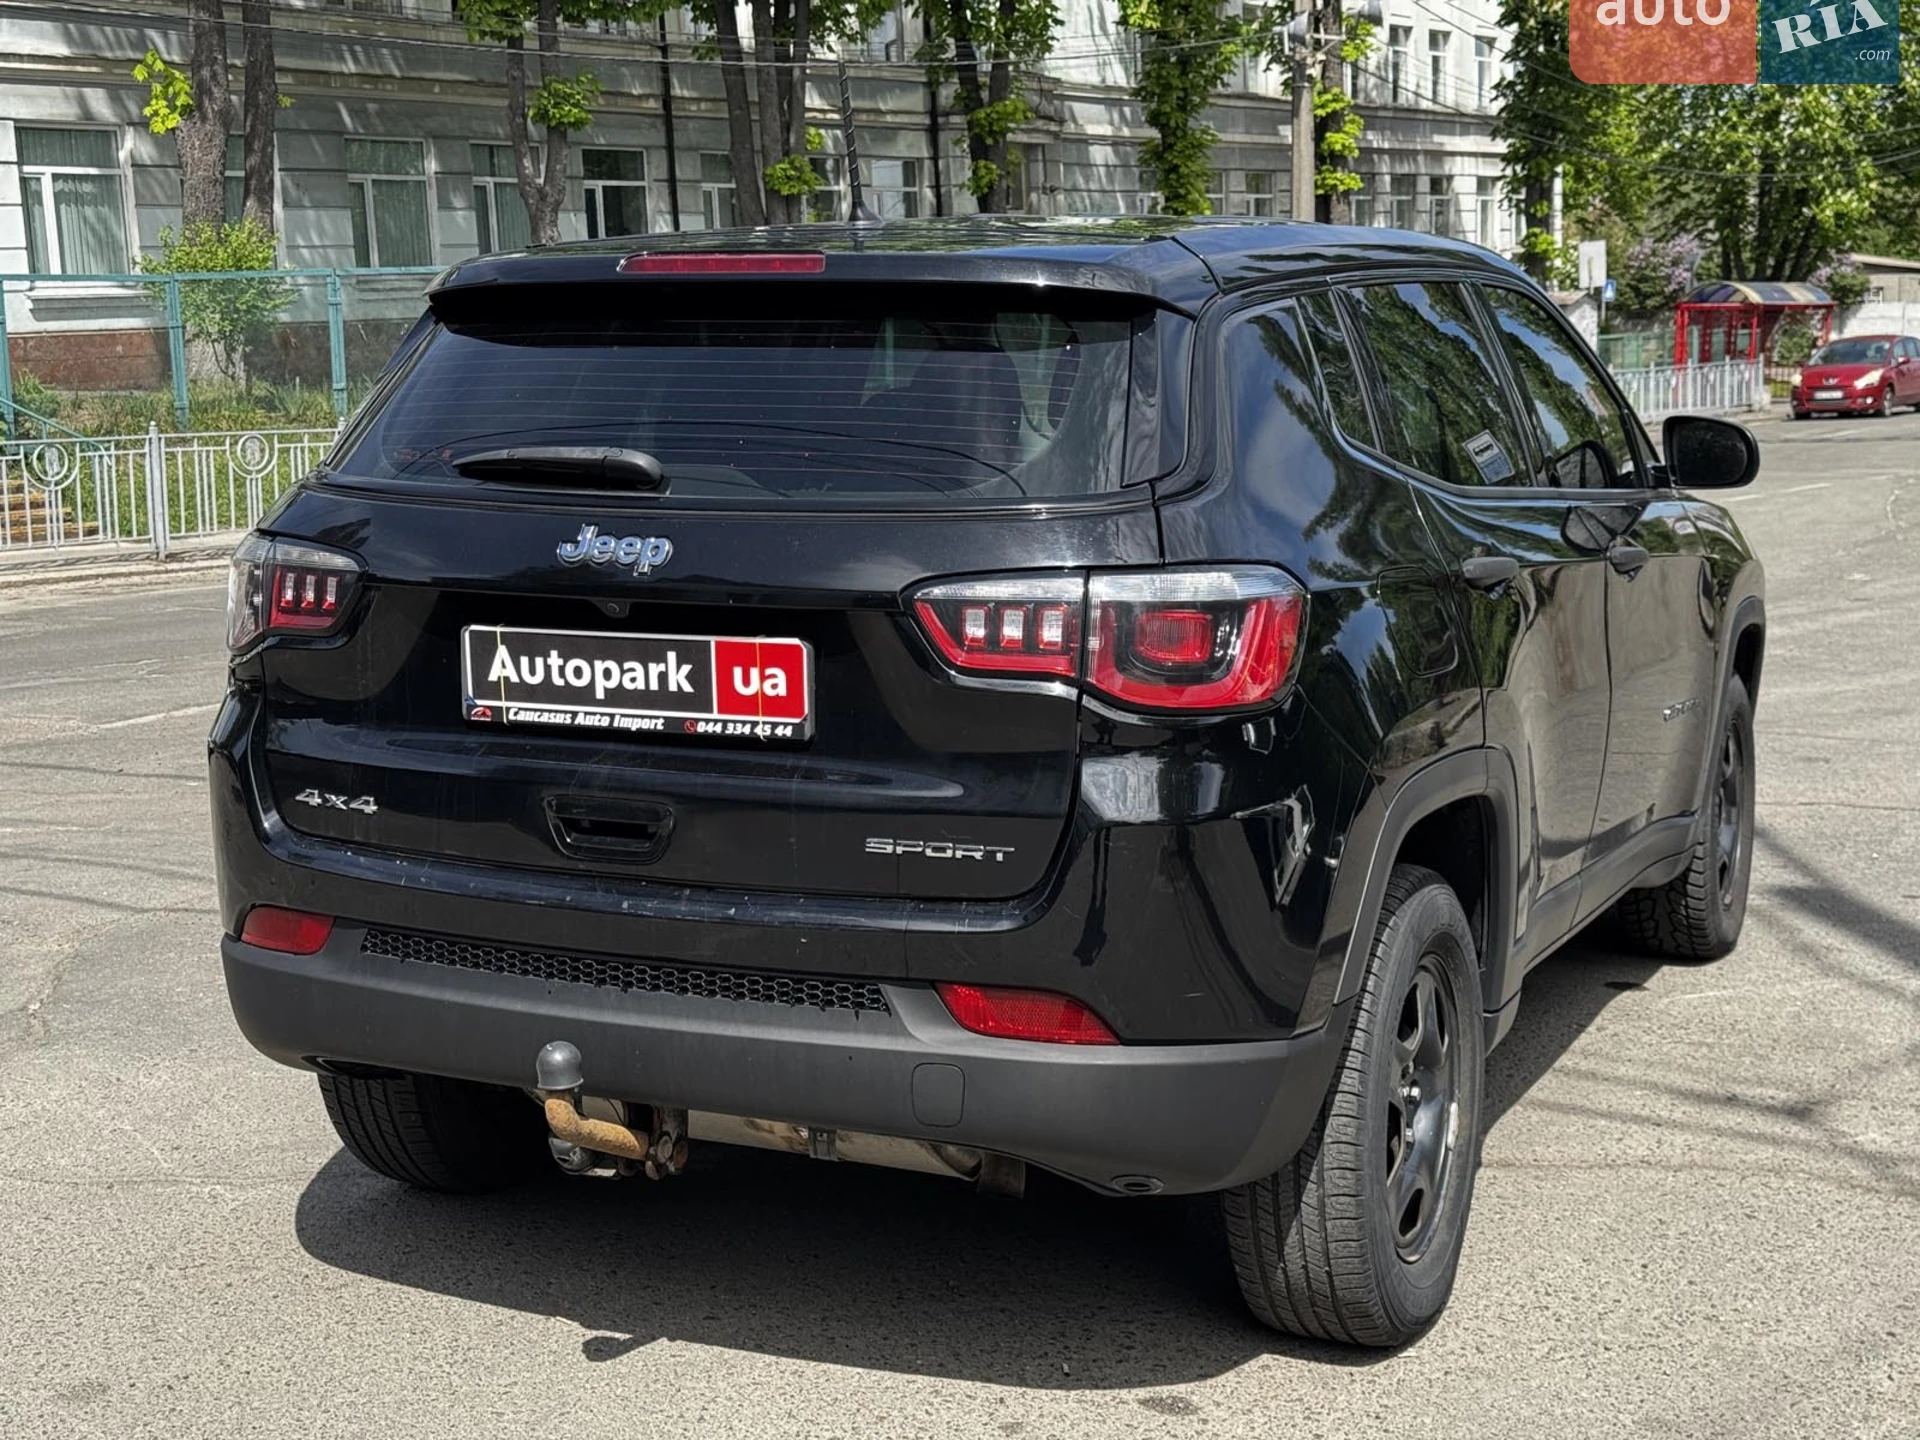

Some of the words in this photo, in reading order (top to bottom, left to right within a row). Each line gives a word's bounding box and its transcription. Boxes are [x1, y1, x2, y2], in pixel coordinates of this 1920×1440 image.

[557, 523, 673, 576] Jeep
[487, 644, 695, 700] Autopark
[732, 665, 788, 698] ua
[508, 707, 572, 725] Caucasus
[574, 712, 610, 727] Auto
[612, 714, 665, 731] Import
[696, 721, 723, 734] 044
[725, 723, 752, 735] 334
[753, 724, 772, 736] 45
[774, 725, 793, 737] 44
[295, 788, 379, 815] 4x4
[864, 837, 1016, 862] SPORT
